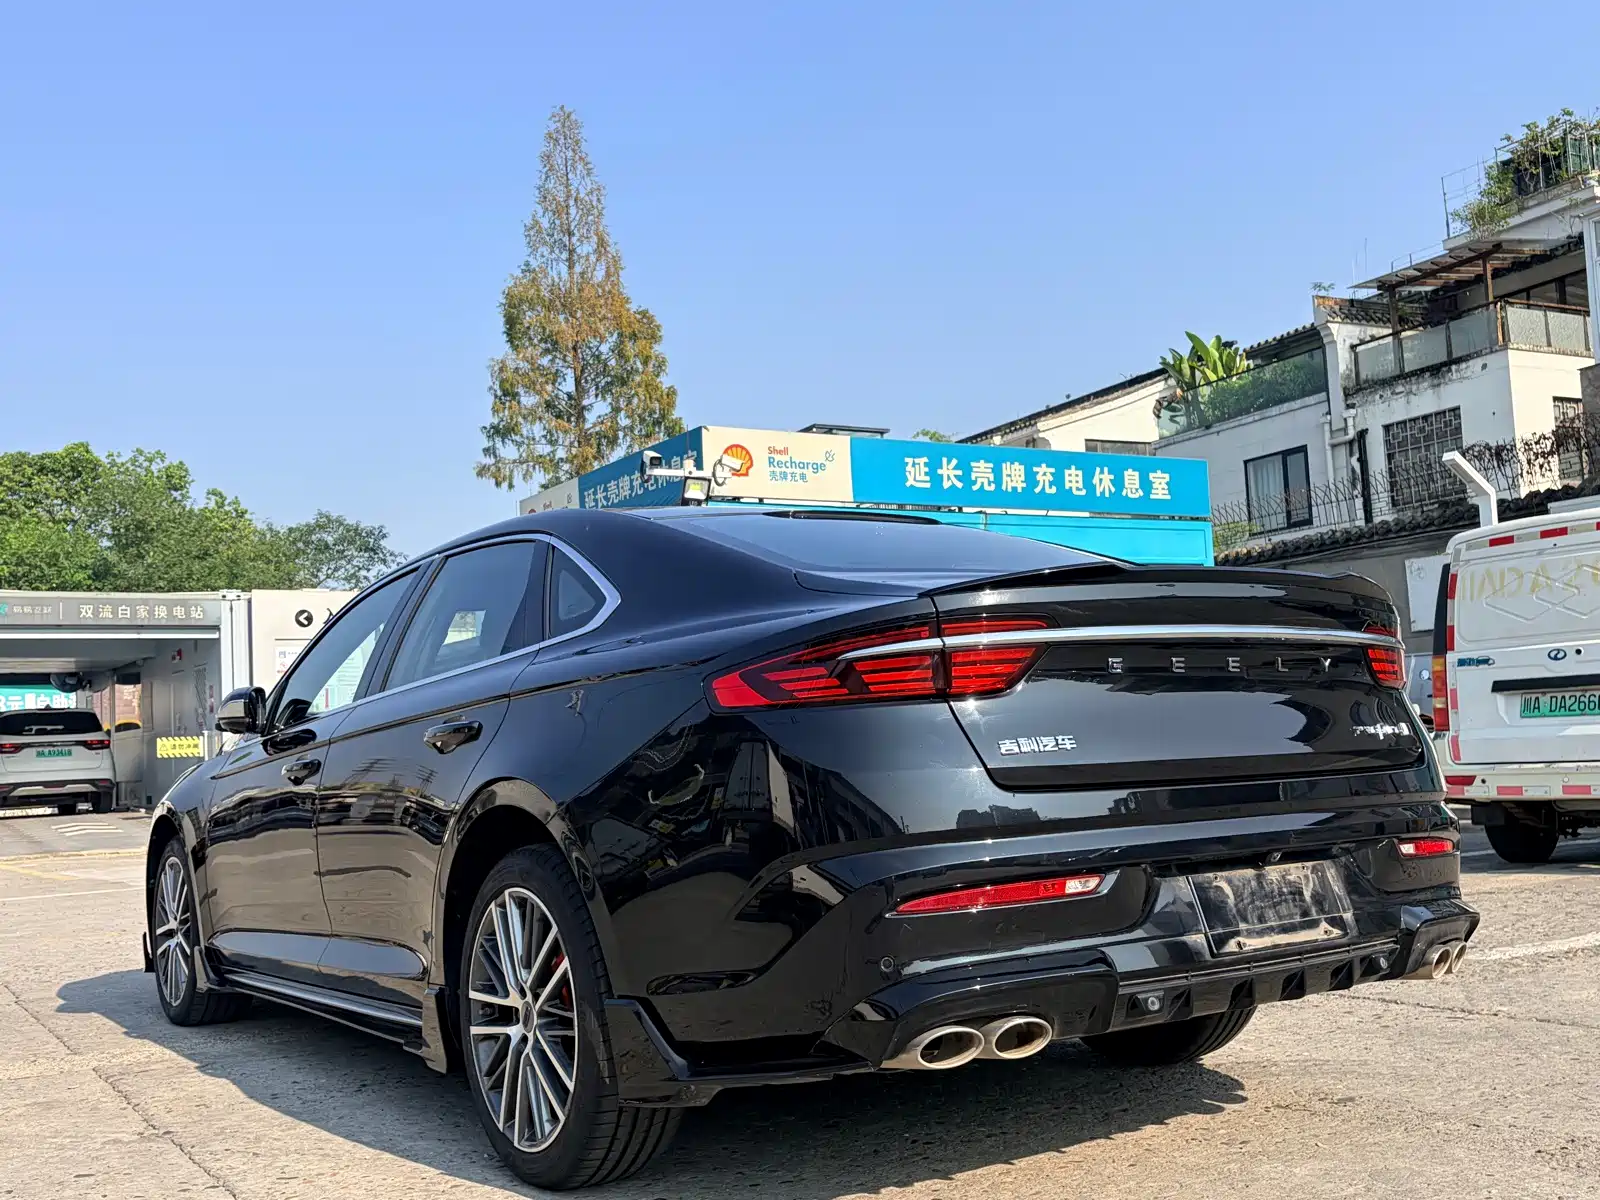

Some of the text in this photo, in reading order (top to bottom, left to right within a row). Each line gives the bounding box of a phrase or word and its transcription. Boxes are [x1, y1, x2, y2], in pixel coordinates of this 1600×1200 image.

[767, 445, 789, 456] Shell
[767, 456, 827, 474] Recharge
[769, 470, 809, 483] 壳牌充电
[904, 456, 1172, 500] 延长壳牌充电休息室
[79, 604, 205, 619] 双流白家换电站
[1107, 656, 1332, 674] GEELY
[1549, 693, 1600, 713] DA266
[998, 734, 1077, 756] 吉利汽车
